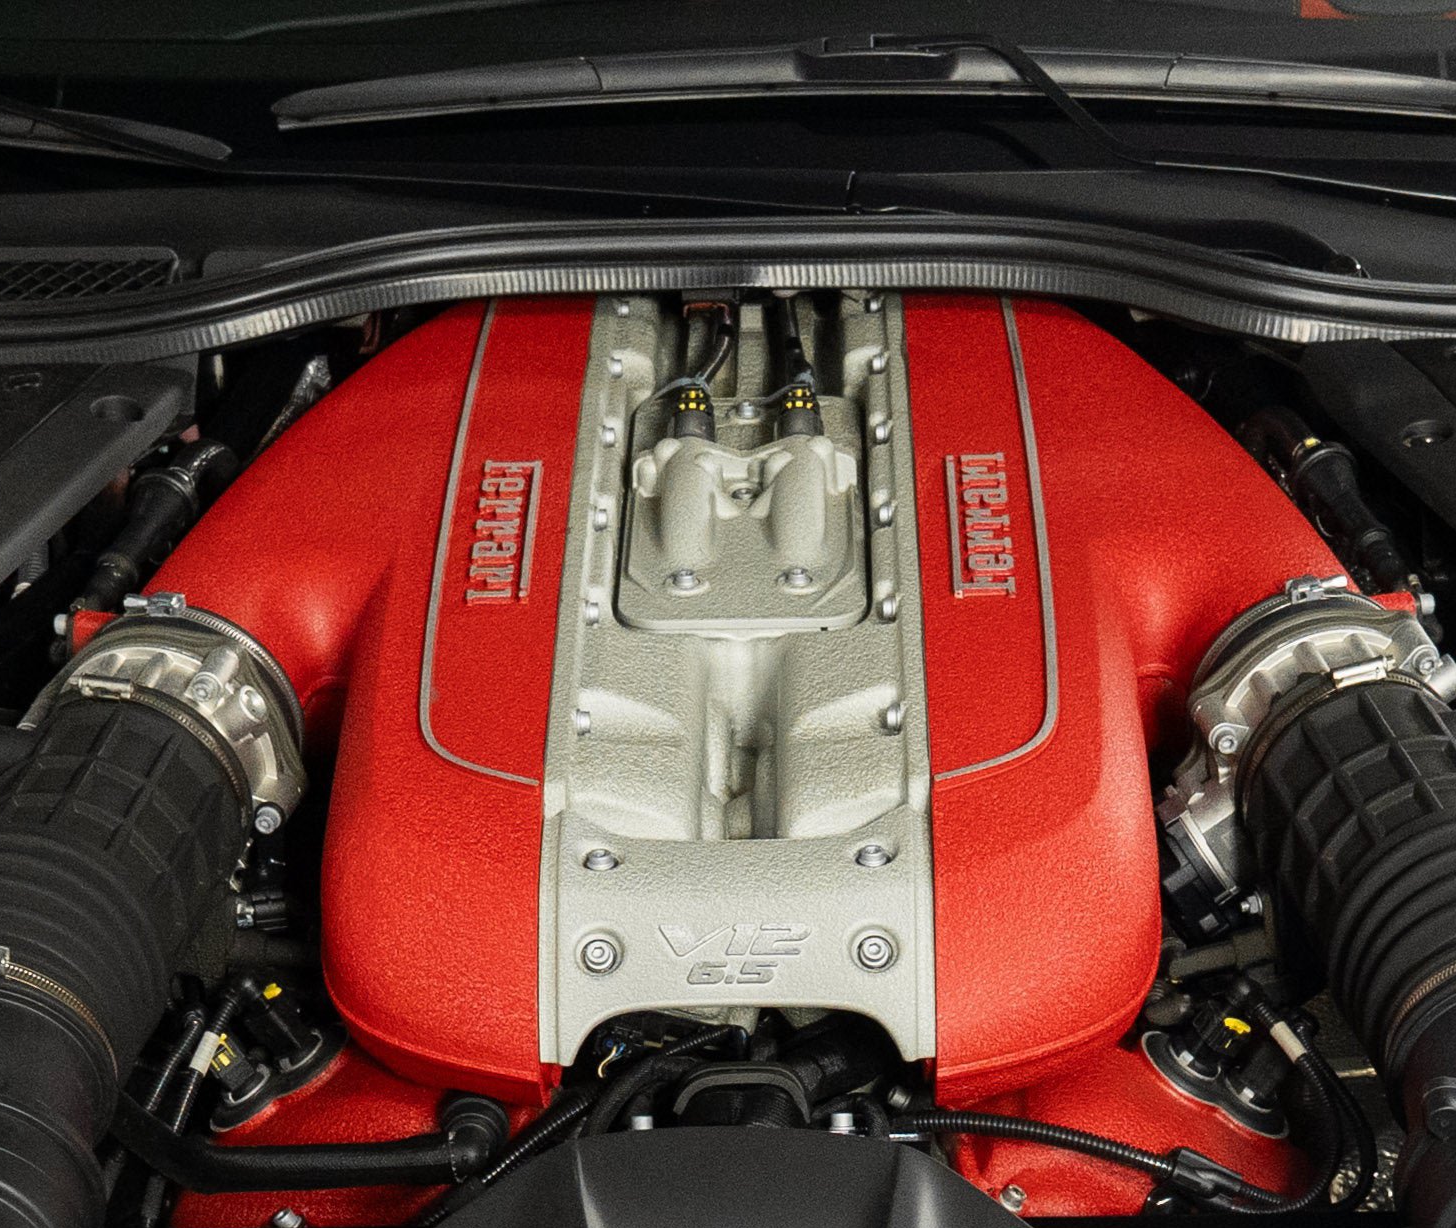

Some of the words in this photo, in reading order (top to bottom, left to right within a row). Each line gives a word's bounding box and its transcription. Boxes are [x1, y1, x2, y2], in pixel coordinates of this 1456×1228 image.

[466, 459, 543, 605] Ferrari
[944, 452, 1016, 598] Ferrari
[658, 922, 812, 957] V12
[686, 961, 779, 986] 6.5
